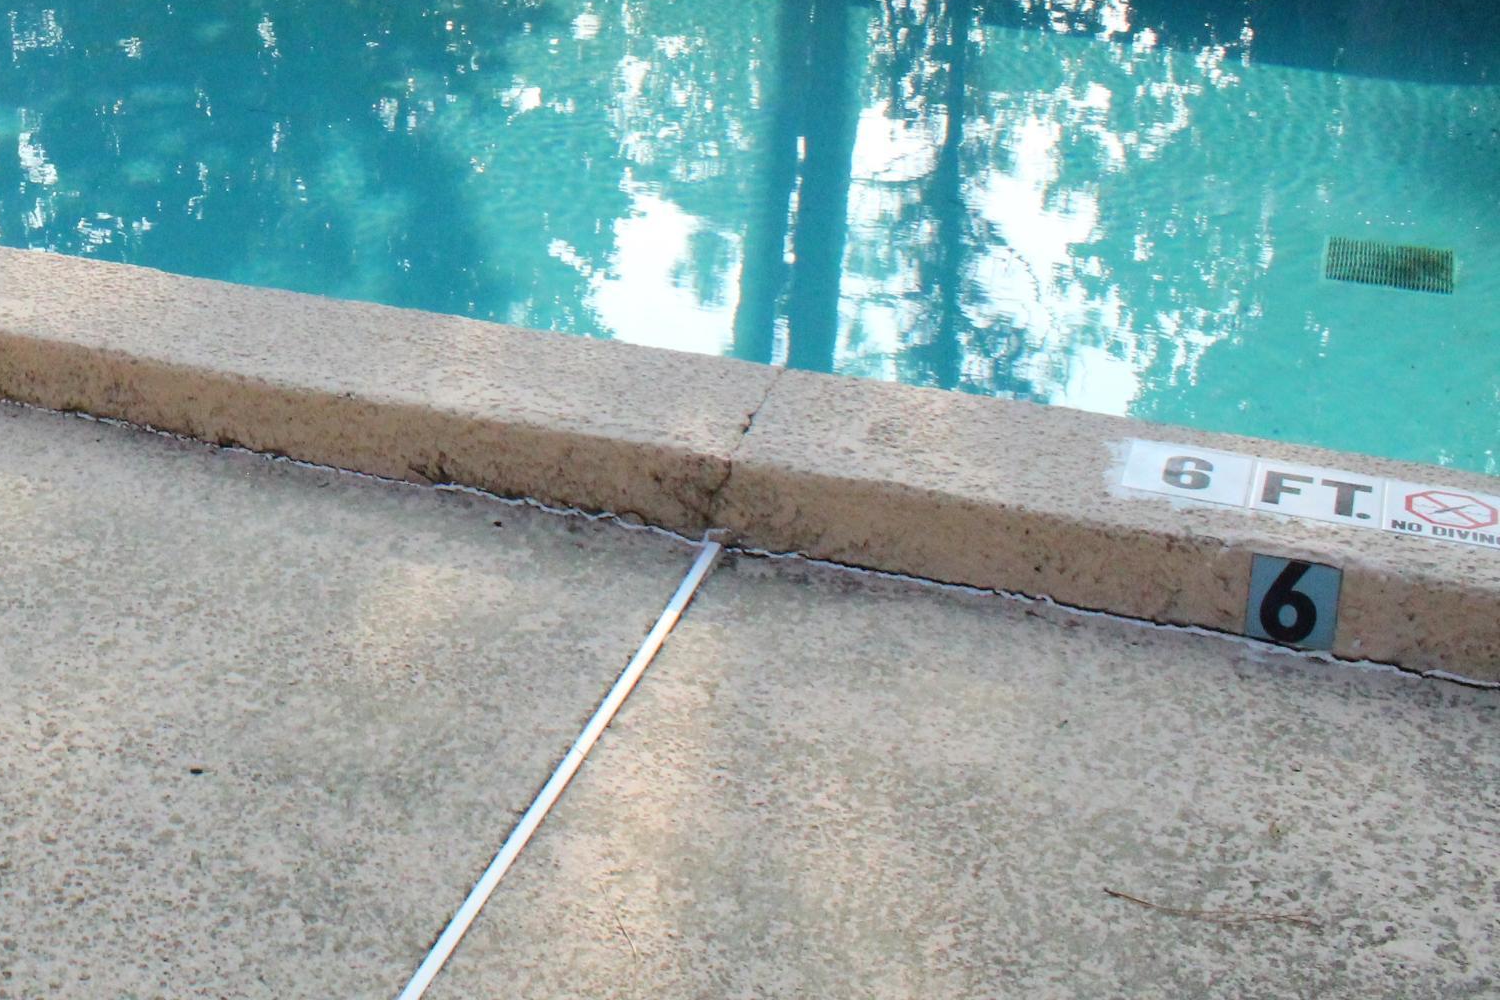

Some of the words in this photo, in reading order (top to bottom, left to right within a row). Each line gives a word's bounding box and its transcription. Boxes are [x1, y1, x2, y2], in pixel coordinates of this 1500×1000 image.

[1162, 455, 1214, 490] 6
[1261, 470, 1373, 520] FT.
[1391, 519, 1422, 532] NO
[1432, 525, 1500, 545] DIVIN
[1259, 559, 1317, 643] 6
